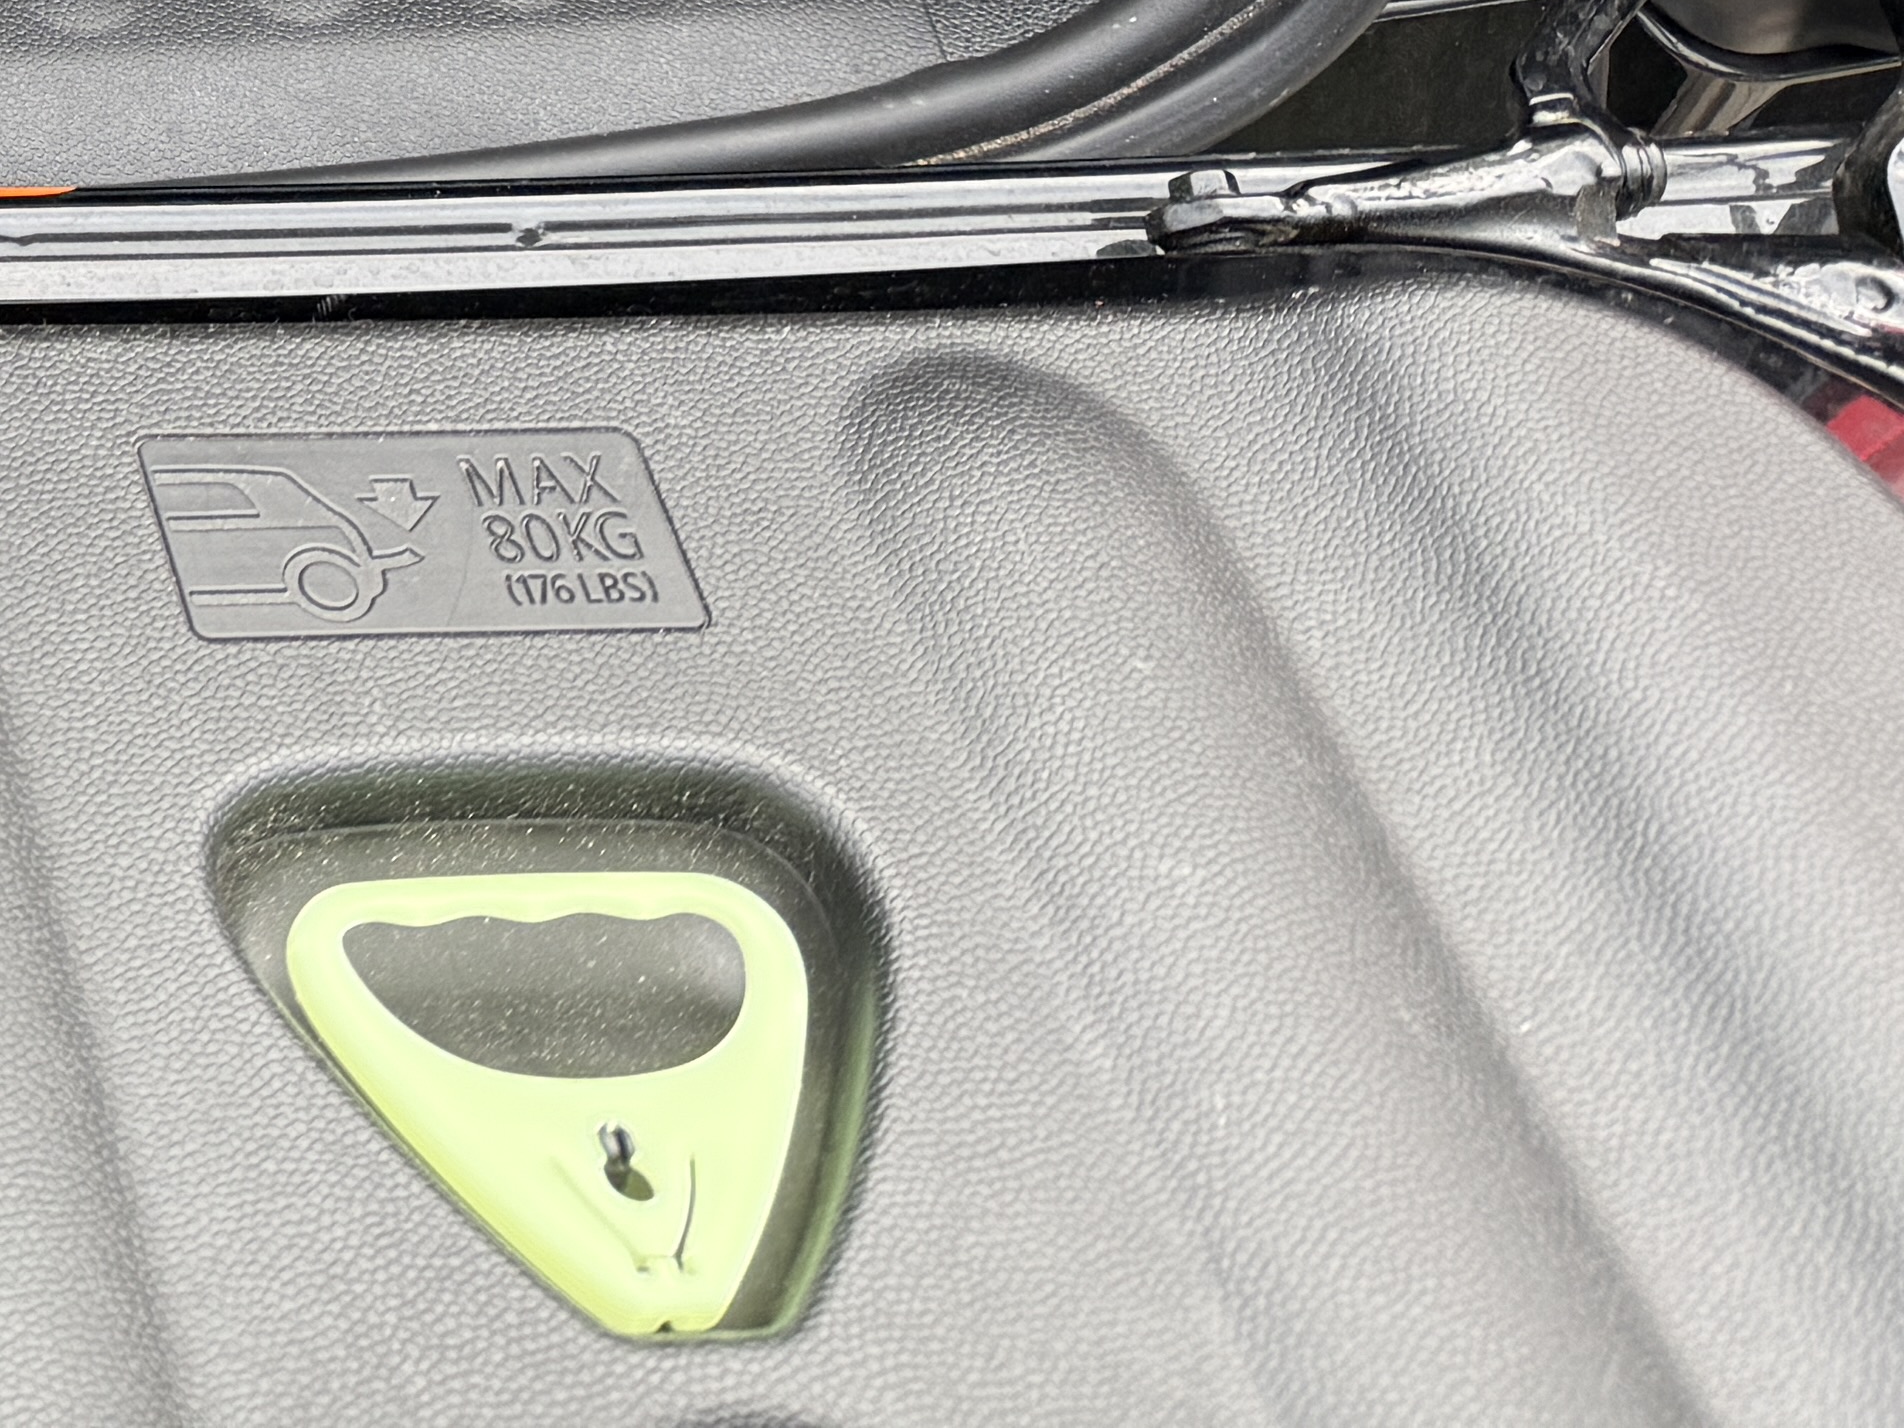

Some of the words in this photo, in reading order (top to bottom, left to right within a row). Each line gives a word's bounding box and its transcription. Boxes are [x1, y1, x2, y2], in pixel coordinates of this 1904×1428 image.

[457, 453, 620, 507] MAX
[481, 509, 645, 564] 80KG
[504, 572, 576, 607] (176
[578, 569, 659, 604] LBS)
